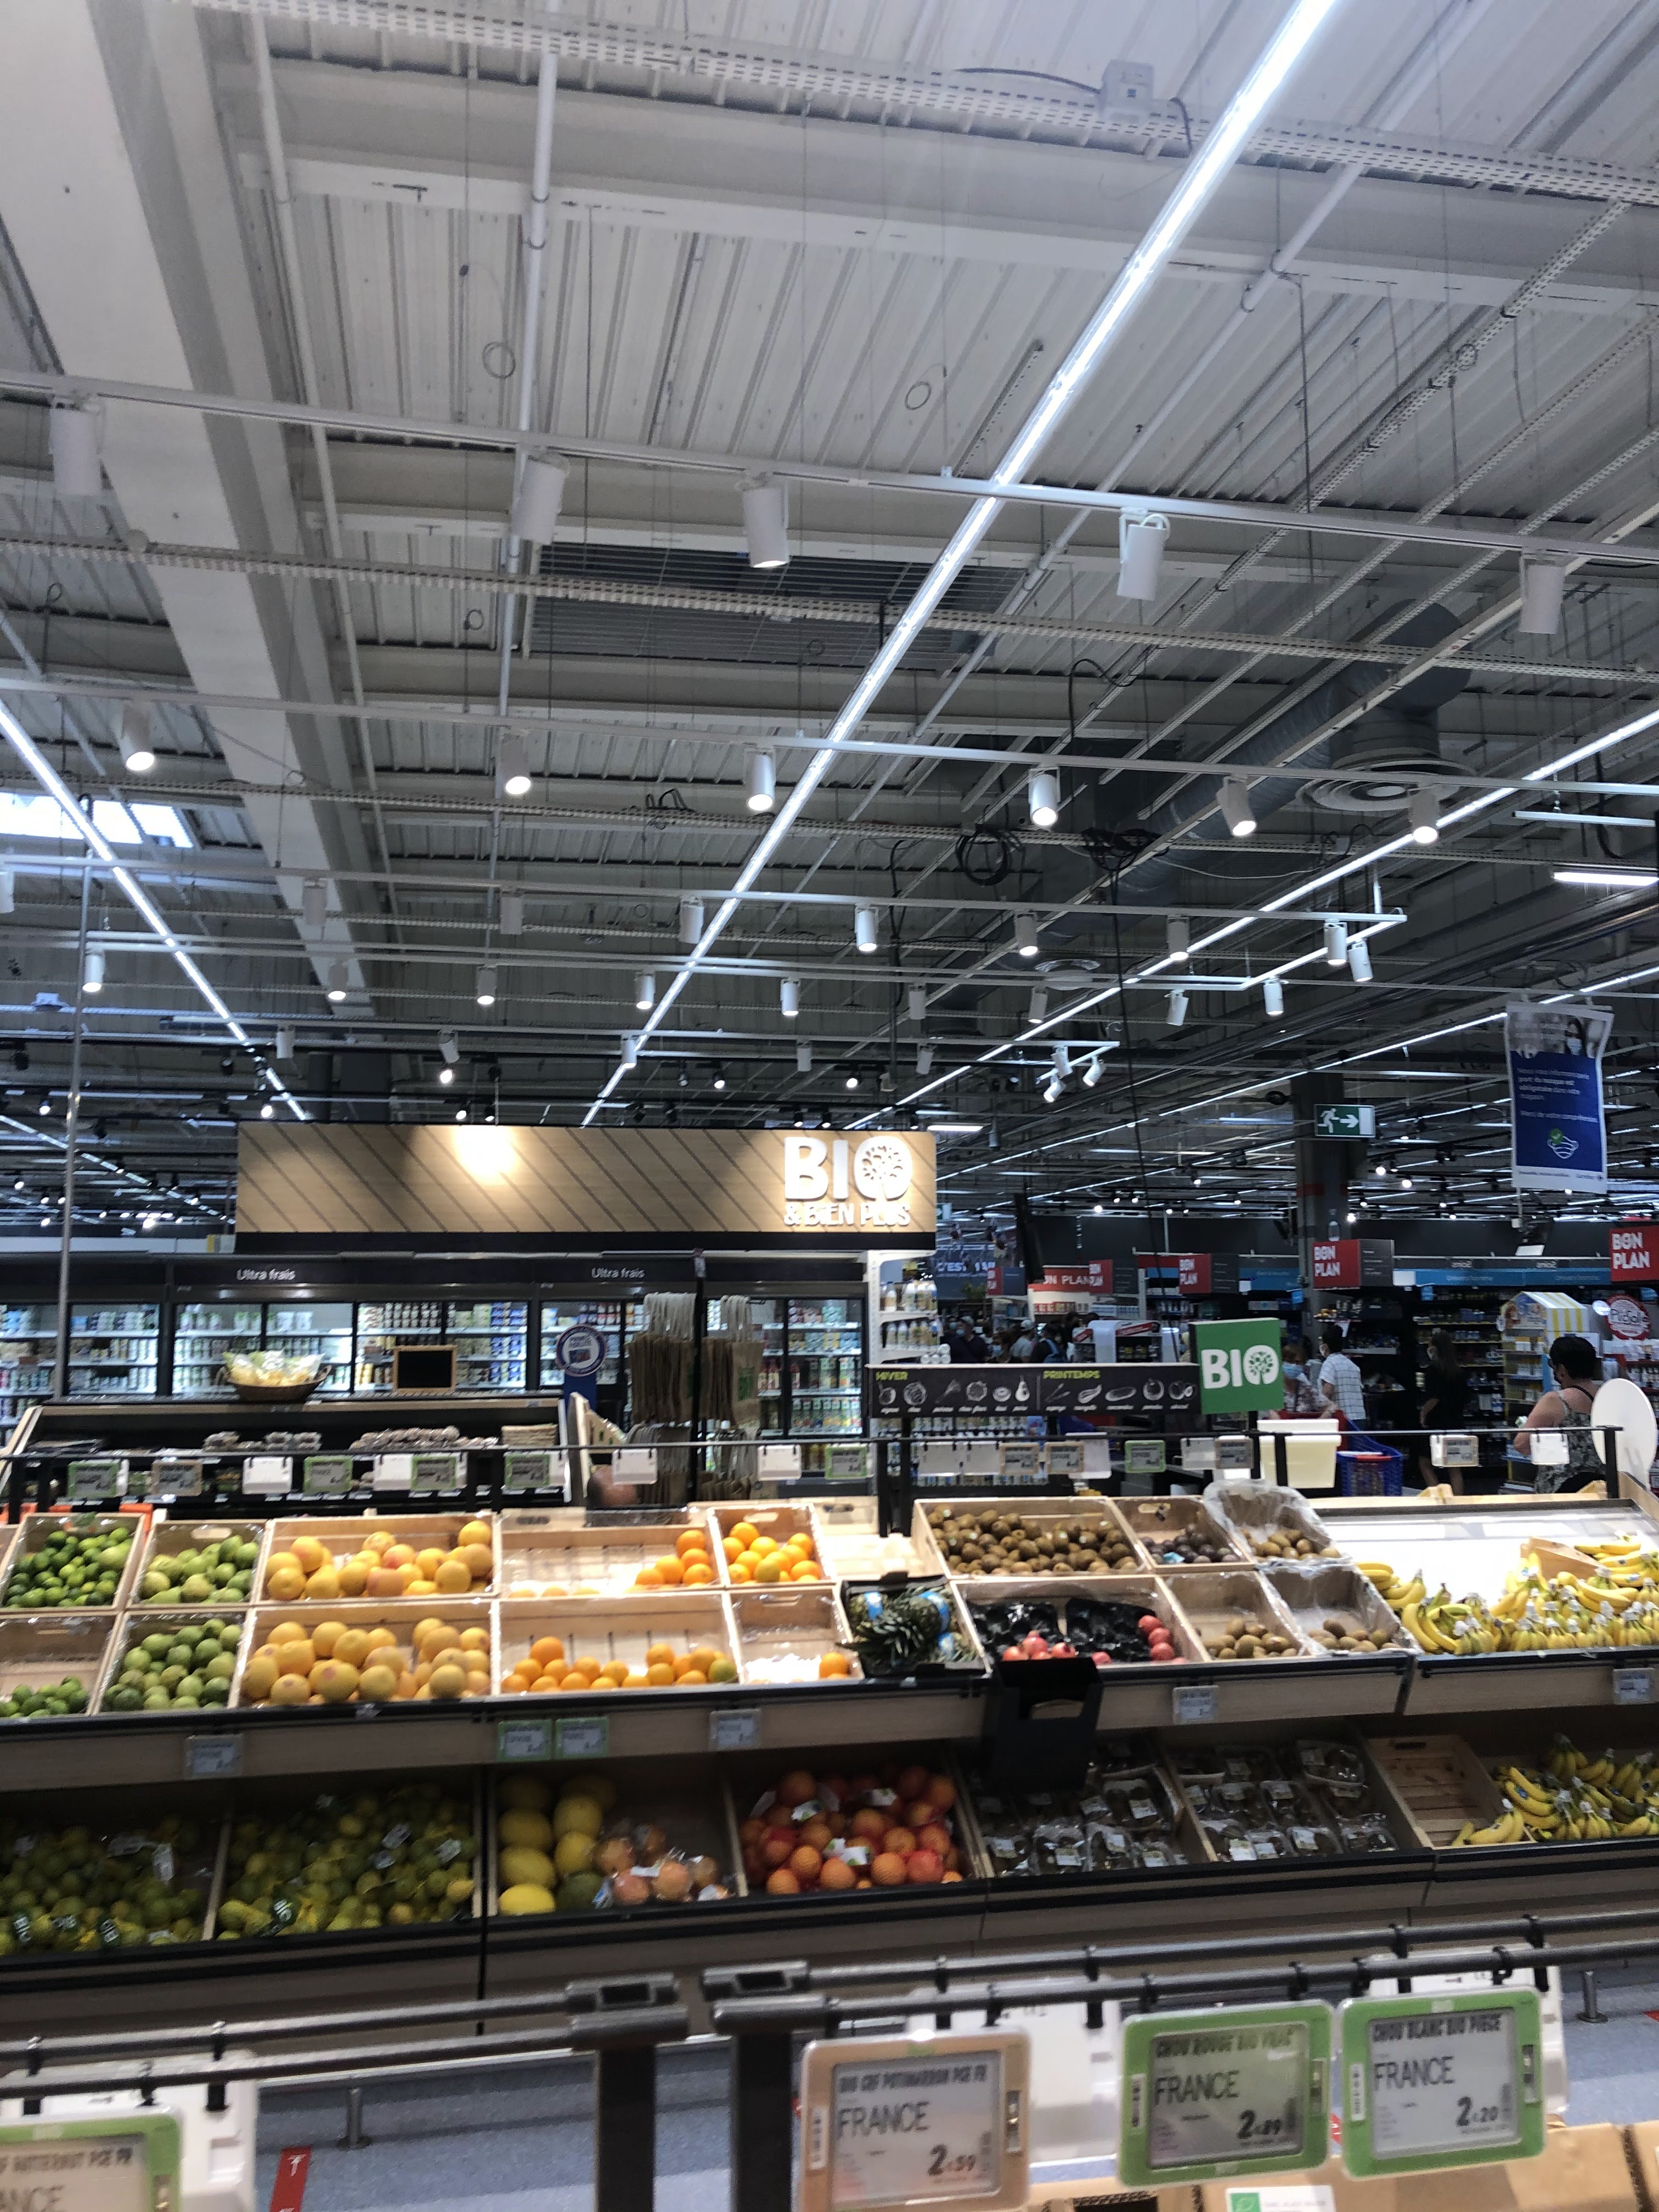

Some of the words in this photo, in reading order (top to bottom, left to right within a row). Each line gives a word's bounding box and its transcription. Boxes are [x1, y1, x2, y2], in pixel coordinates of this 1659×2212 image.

[784, 1136, 913, 1201] BIO
[783, 1203, 802, 1226] &
[860, 1203, 911, 1226] PLUS
[1612, 1232, 1643, 1250] BON
[1314, 1245, 1336, 1260] BON
[1612, 1251, 1651, 1269] PLAN
[236, 1268, 267, 1280] Ultra
[268, 1268, 296, 1280] frais
[591, 1267, 619, 1278] Ultra
[620, 1267, 645, 1278] frais
[1314, 1262, 1341, 1277] PLAN
[876, 1371, 909, 1381] HIVER
[1201, 1345, 1279, 1389] BIO
[1373, 2056, 1455, 2091] FRANCE
[1154, 2069, 1240, 2106] FRANCE
[838, 2100, 931, 2139] FRANCE
